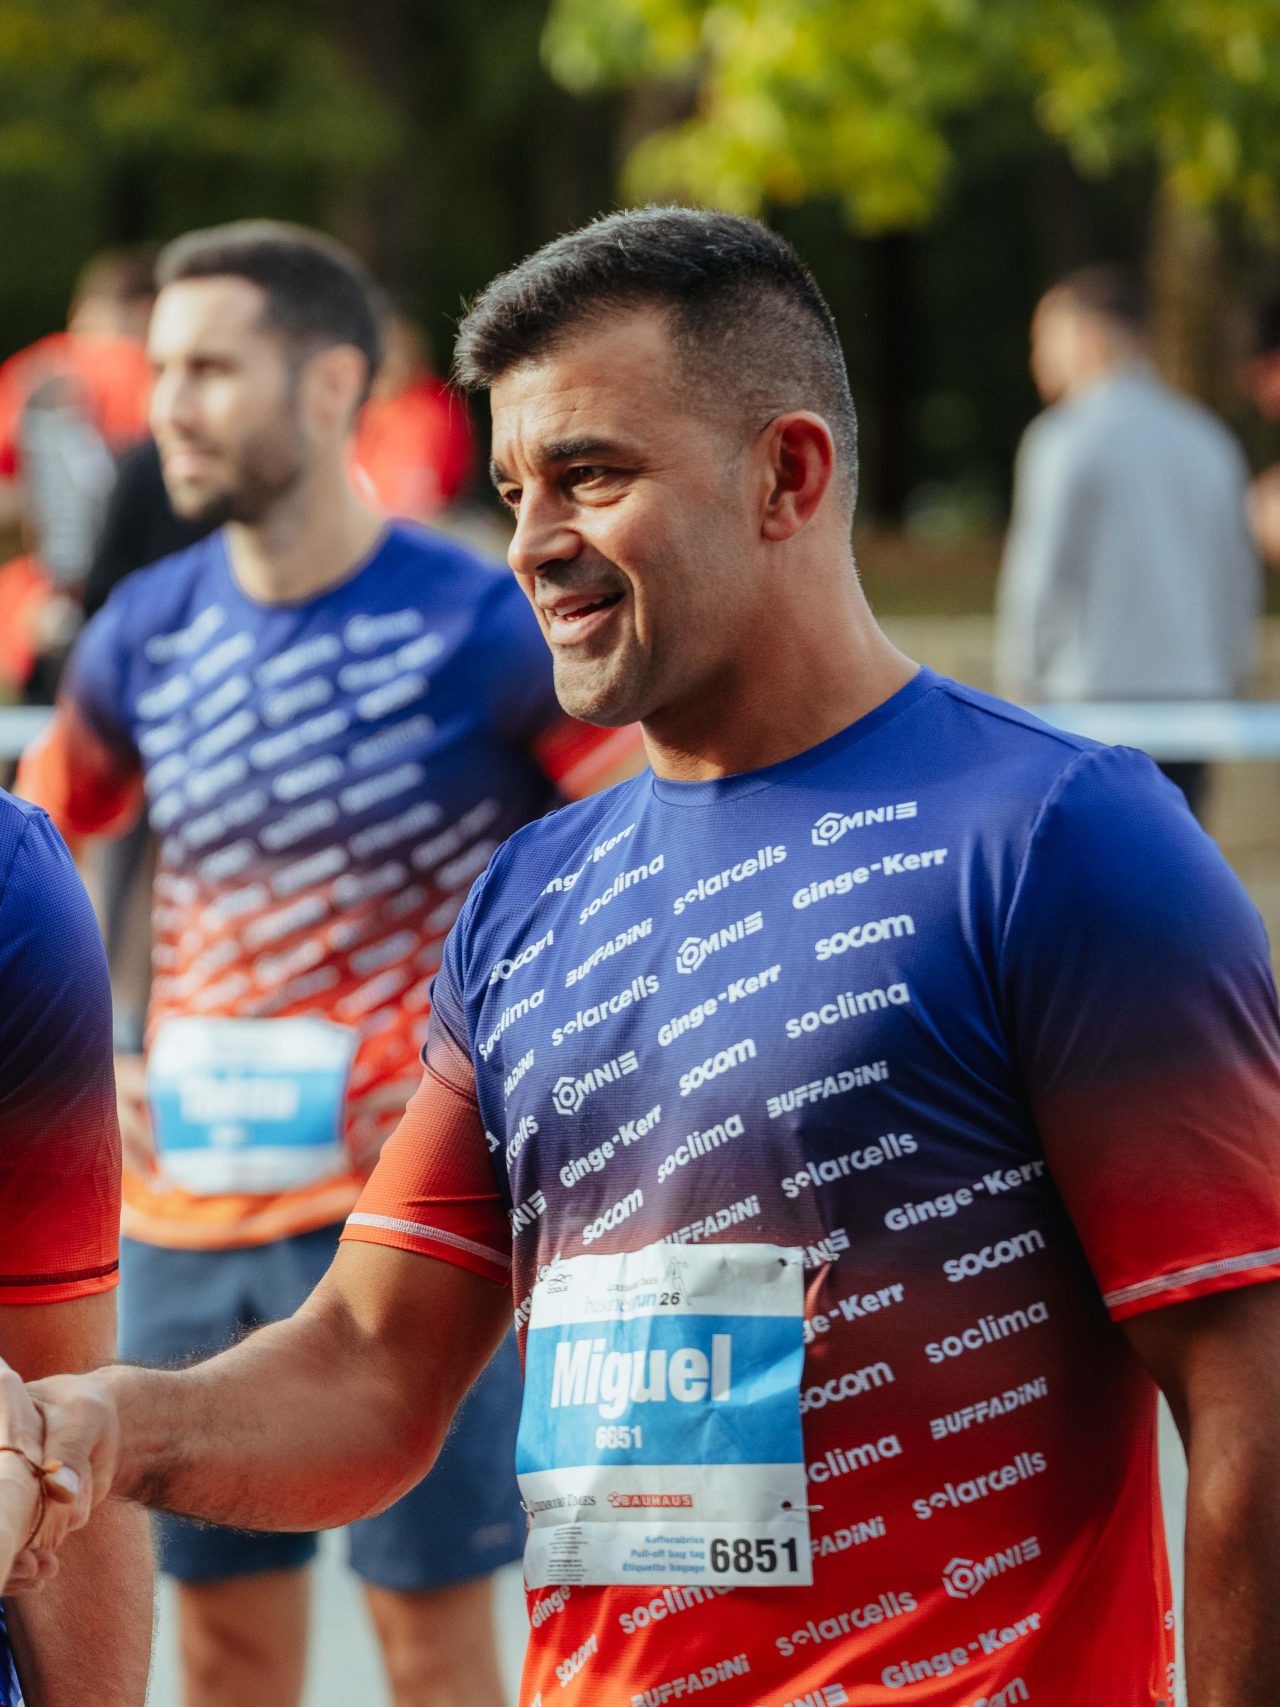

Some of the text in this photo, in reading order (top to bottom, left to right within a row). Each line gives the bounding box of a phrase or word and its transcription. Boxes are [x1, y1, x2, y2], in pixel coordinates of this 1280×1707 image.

[579, 855, 664, 925] soclima
[673, 845, 787, 916] solarcells
[792, 848, 948, 910] Ginge-Kerr
[815, 914, 915, 961] socom
[552, 975, 660, 1047] solarcells
[657, 964, 781, 1047] Ginge-Kerr
[785, 982, 910, 1039] soclima
[679, 1039, 757, 1097] socom
[559, 1104, 662, 1188] Ginge-Kerr
[657, 1114, 745, 1184] soclima
[781, 1133, 919, 1198] solarcells
[582, 1189, 644, 1245] socom
[884, 1160, 1045, 1231] Ginge-Kerr
[943, 1229, 1046, 1283] socom
[659, 1292, 680, 1306] 26
[804, 1283, 904, 1343] ge-Kerr
[925, 1302, 1049, 1364] soclima
[551, 1334, 732, 1419] Miguel
[596, 1426, 642, 1449] 6851
[806, 1435, 903, 1483] clima
[623, 1495, 692, 1506] BAUHAUS
[912, 1452, 1047, 1520] solarcells
[710, 1538, 799, 1573] 6851
[775, 1591, 918, 1657] solarcells
[881, 1612, 1041, 1689] Ginge-Kerr
